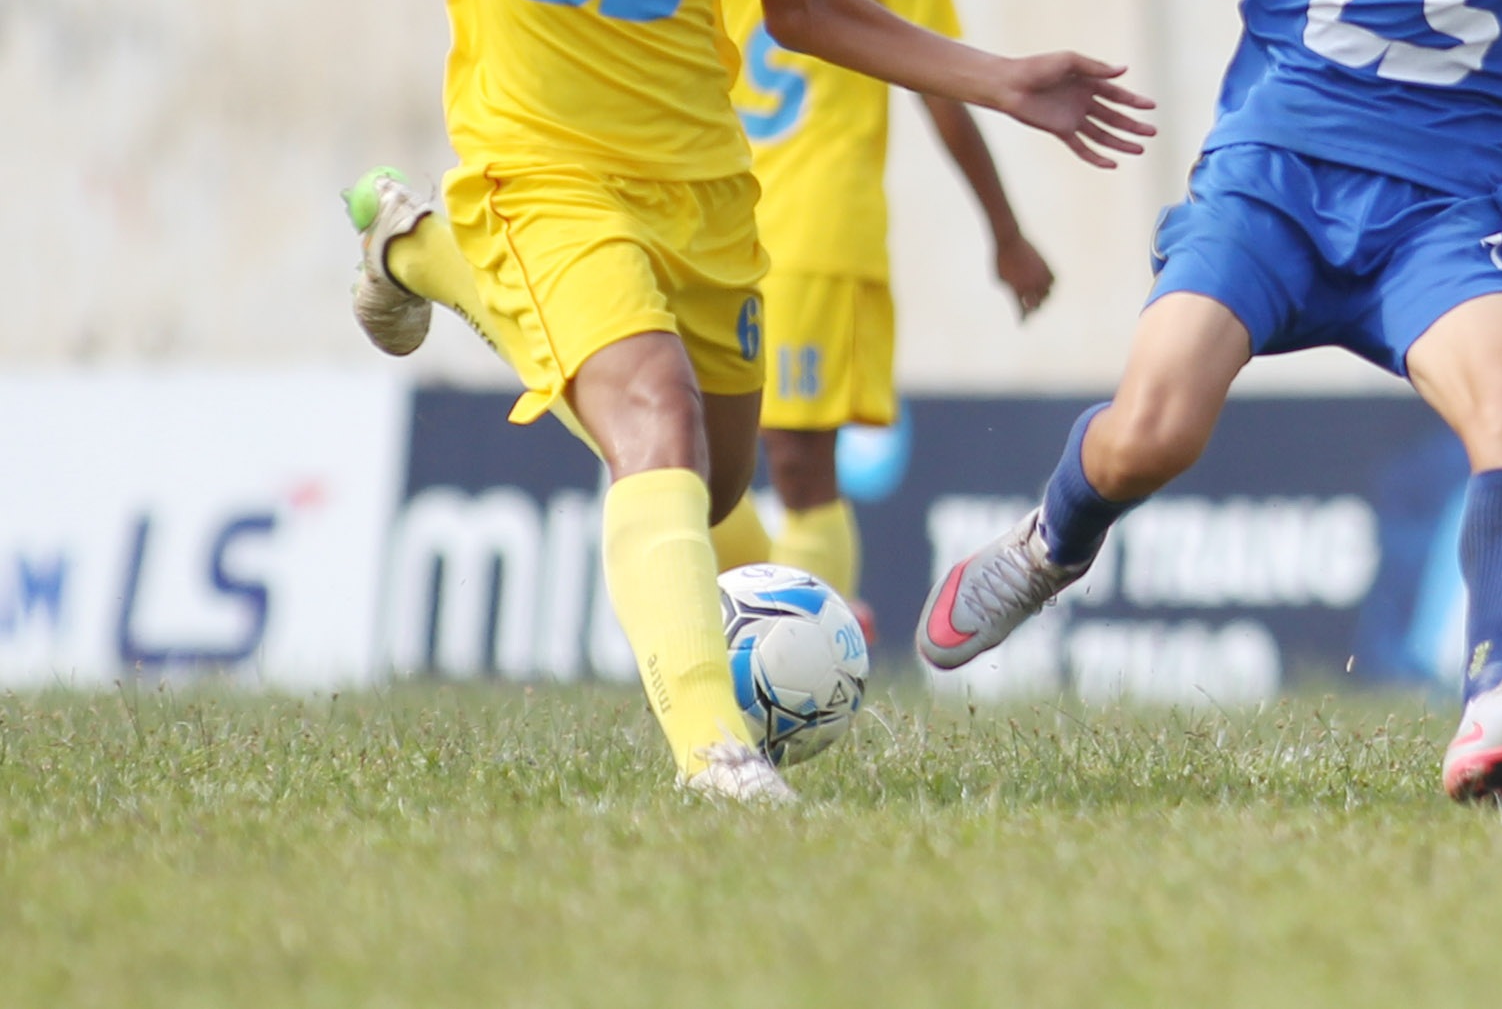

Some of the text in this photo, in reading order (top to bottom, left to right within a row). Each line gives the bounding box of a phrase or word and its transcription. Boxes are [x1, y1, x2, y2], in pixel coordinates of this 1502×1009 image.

[736, 17, 808, 141] S
[736, 296, 760, 362] 6
[113, 508, 277, 668] LS
